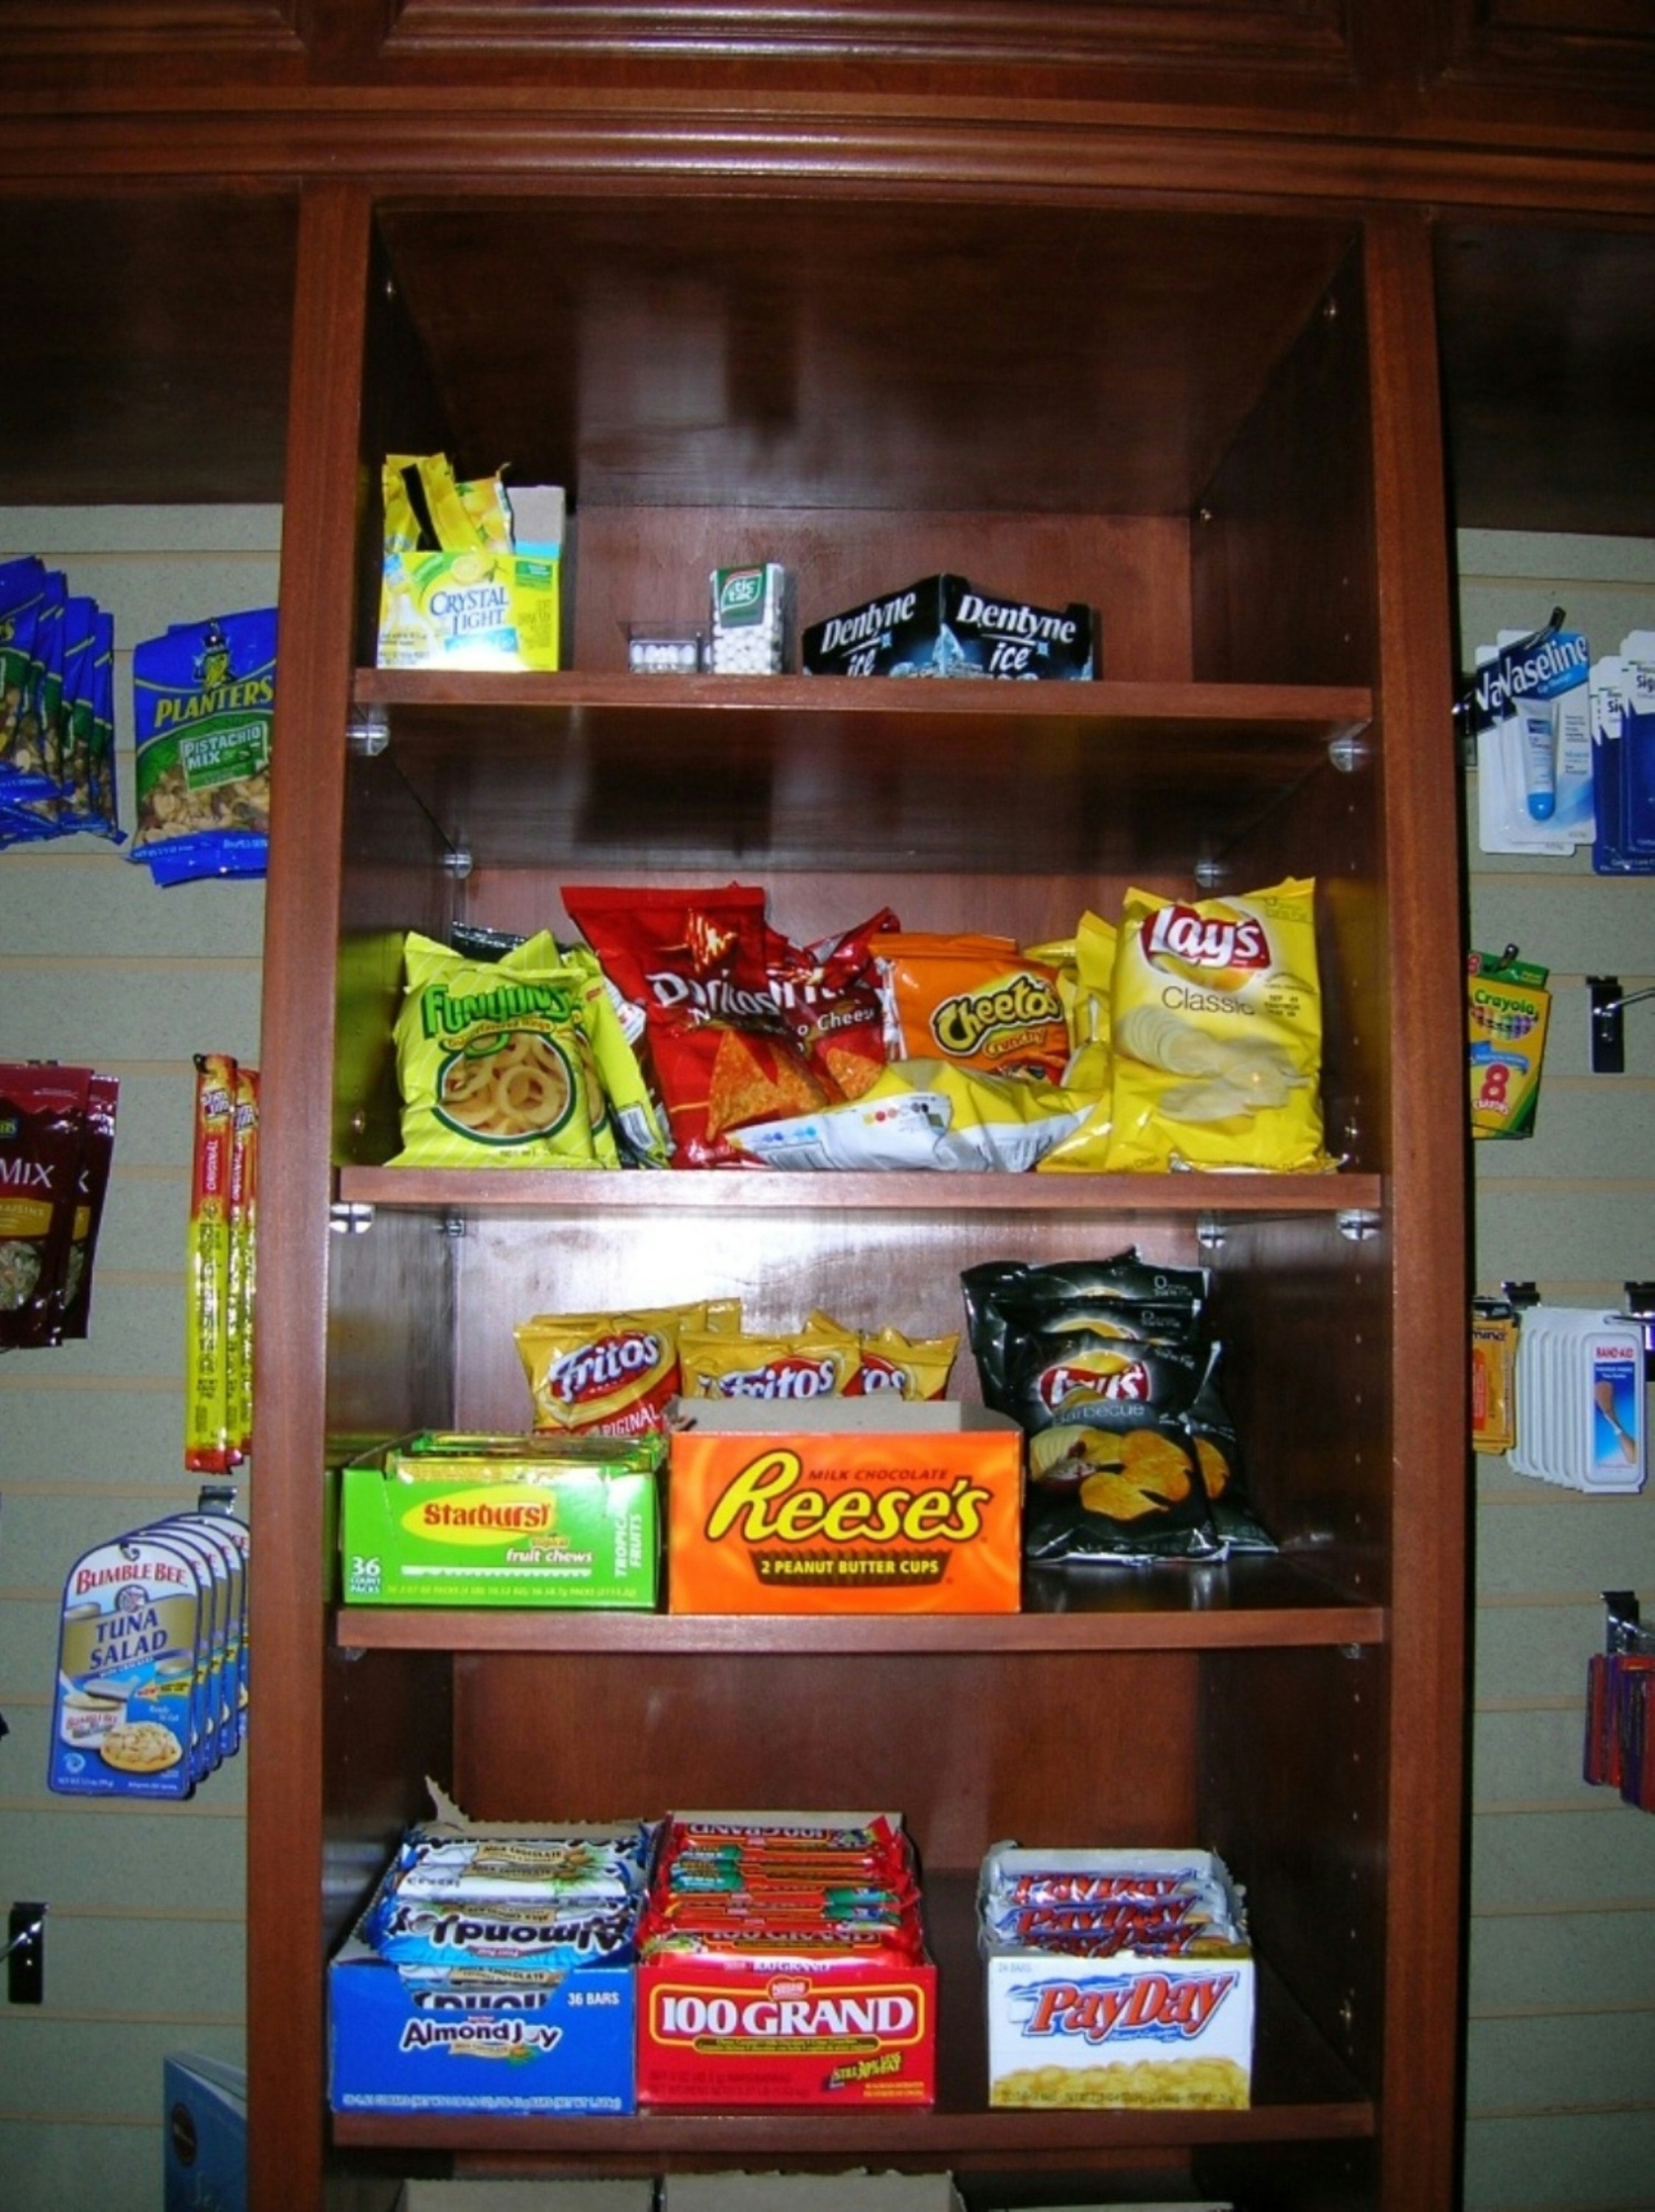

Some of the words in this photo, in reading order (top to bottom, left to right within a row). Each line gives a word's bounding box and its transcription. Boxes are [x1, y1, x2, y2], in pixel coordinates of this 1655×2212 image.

[430, 586, 509, 616] CRYSTAL
[452, 609, 505, 636] LIGHT
[820, 592, 917, 655] Dentyne
[956, 592, 1077, 644] Dentyne
[988, 639, 1030, 671] ice
[1498, 636, 1588, 697] Vaseline
[154, 675, 274, 728] PLANTERS
[184, 725, 262, 755] PISTACHIO
[187, 751, 221, 771] MIX
[931, 972, 1064, 1057] Cheetos
[1162, 985, 1256, 1016] Classic
[1474, 988, 1536, 1016] Crayola
[1480, 1062, 1510, 1104] 8
[549, 1333, 661, 1402] Fritos
[808, 1469, 850, 1481] MILK
[854, 1469, 948, 1481] CHOCOLATE
[705, 1447, 996, 1543] Reese's
[423, 1502, 551, 1528] Starburst
[352, 1557, 381, 1576] 36
[506, 1548, 541, 1562] fruit
[545, 1548, 593, 1562] chews
[761, 1559, 771, 1575] 2
[774, 1559, 834, 1575] PEANUT
[838, 1559, 895, 1575] BUTTER
[900, 1559, 940, 1575] CUPS
[76, 1562, 152, 1596] BUMBLE
[154, 1562, 186, 1584] BEE
[96, 1609, 159, 1644] TUNA
[90, 1630, 169, 1671] SALAD
[567, 1992, 583, 2006] 36
[586, 1992, 620, 2006] BARS
[1024, 1972, 1241, 2045] PayDay
[662, 1996, 738, 2034] 100
[742, 1995, 915, 2036] GRAND
[402, 2021, 510, 2049] Almond
